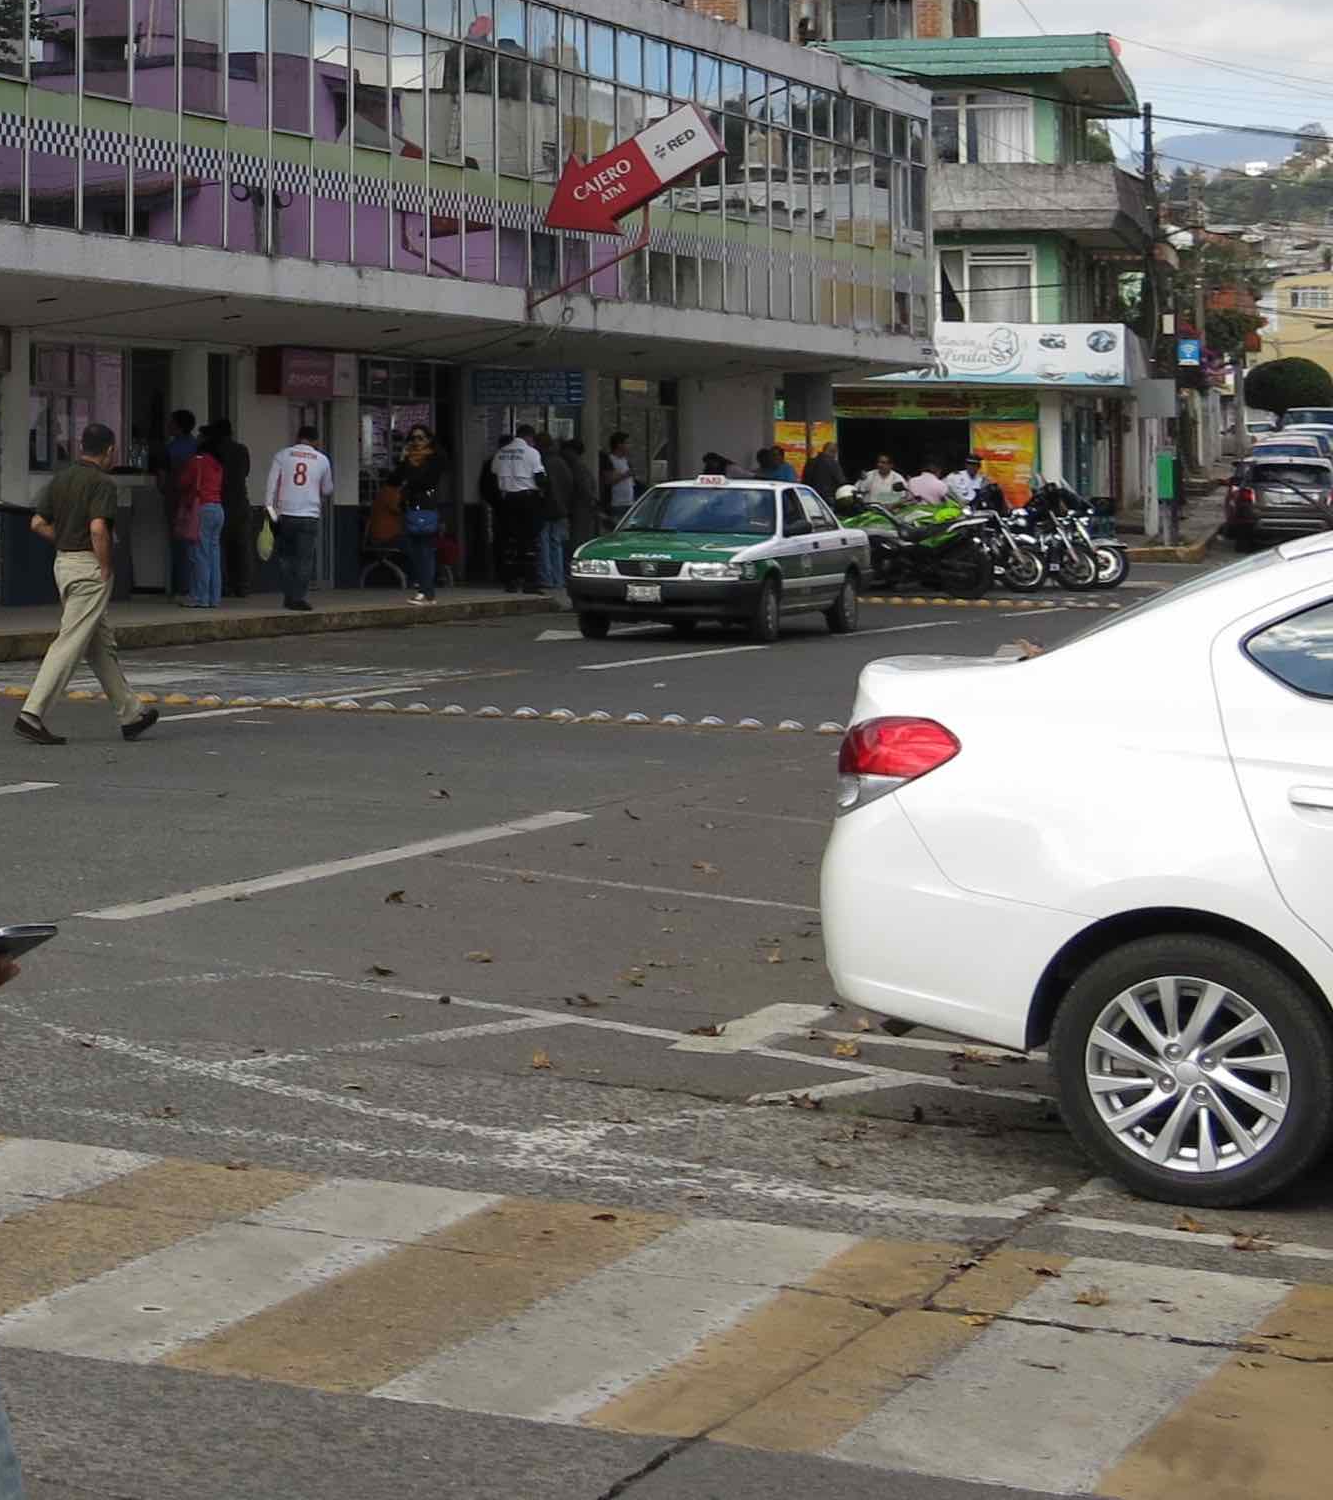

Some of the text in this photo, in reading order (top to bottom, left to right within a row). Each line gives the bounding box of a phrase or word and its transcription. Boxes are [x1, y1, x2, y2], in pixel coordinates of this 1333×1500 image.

[668, 128, 695, 152] RED
[573, 158, 632, 201] CAJERO
[601, 182, 628, 205] ATM
[293, 462, 307, 486] 8
